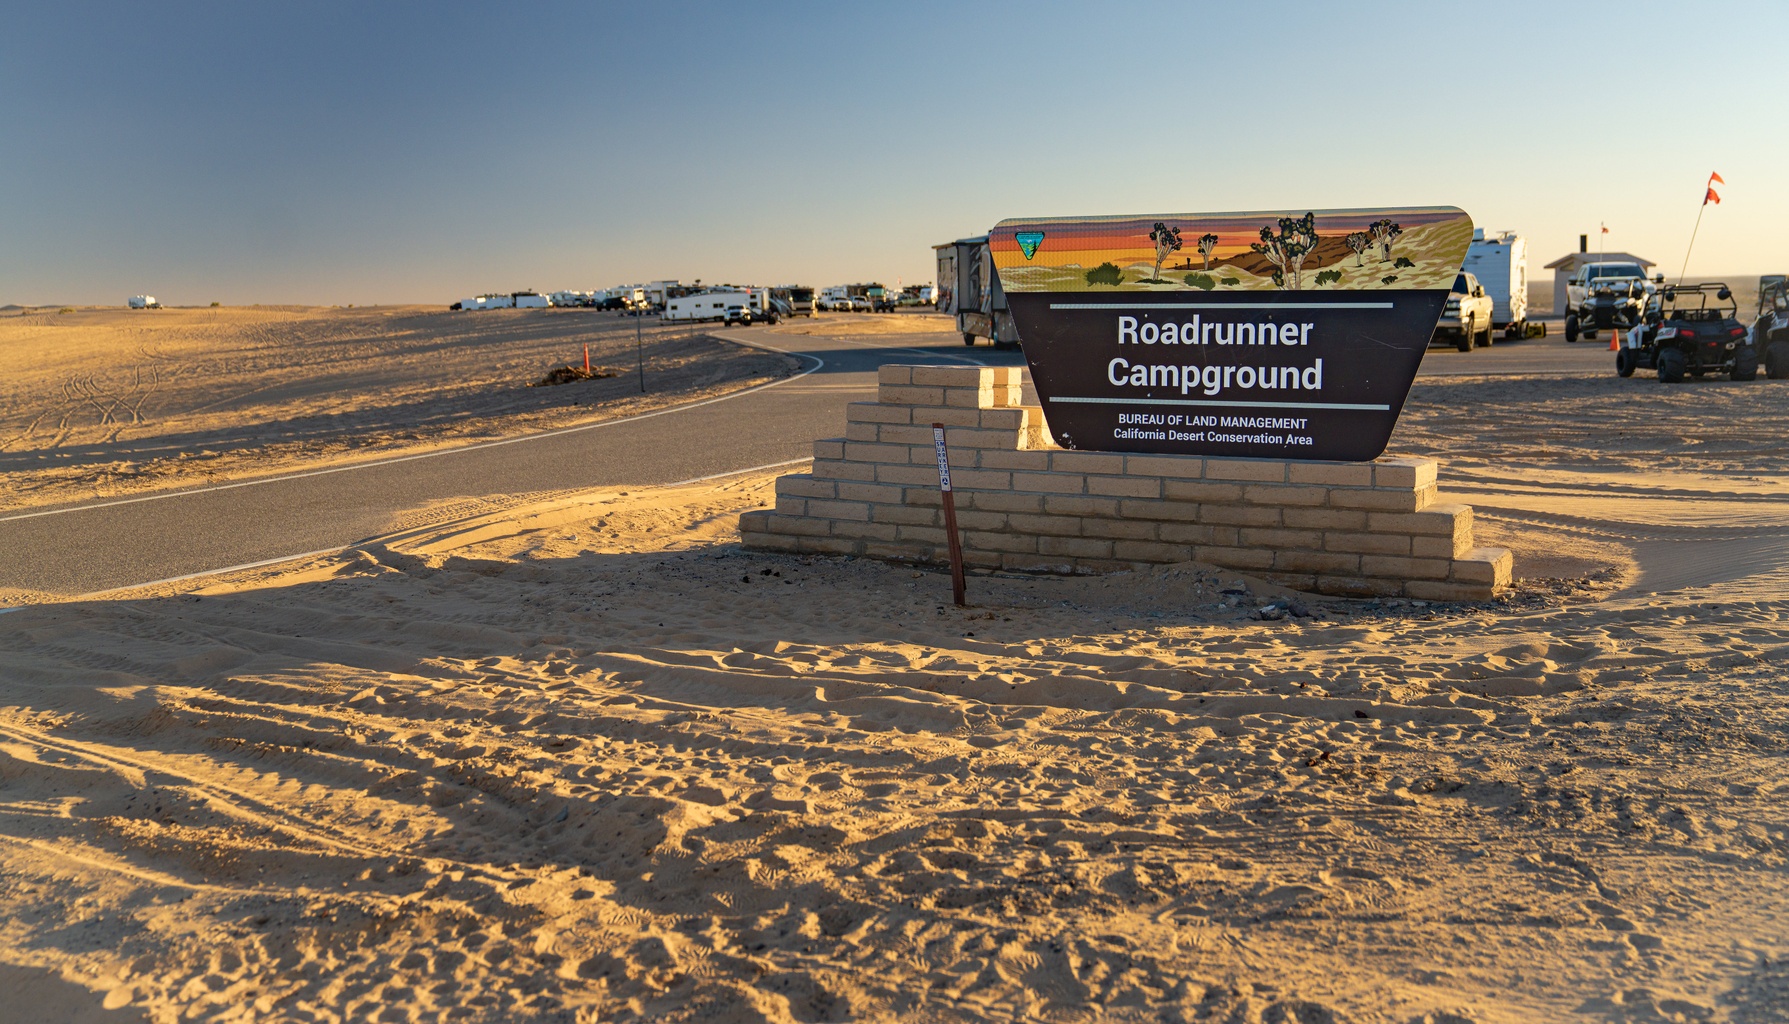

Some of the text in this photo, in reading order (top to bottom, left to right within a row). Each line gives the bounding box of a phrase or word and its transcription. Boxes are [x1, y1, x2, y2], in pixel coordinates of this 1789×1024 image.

[1118, 314, 1314, 346] Roadrunner
[1108, 357, 1323, 396] Campground
[1113, 428, 1313, 446] California Desert Conservation Area
[1118, 413, 1308, 429] BUREAU OF LAND MANAGEMENT
[940, 442, 948, 474] MARKER
